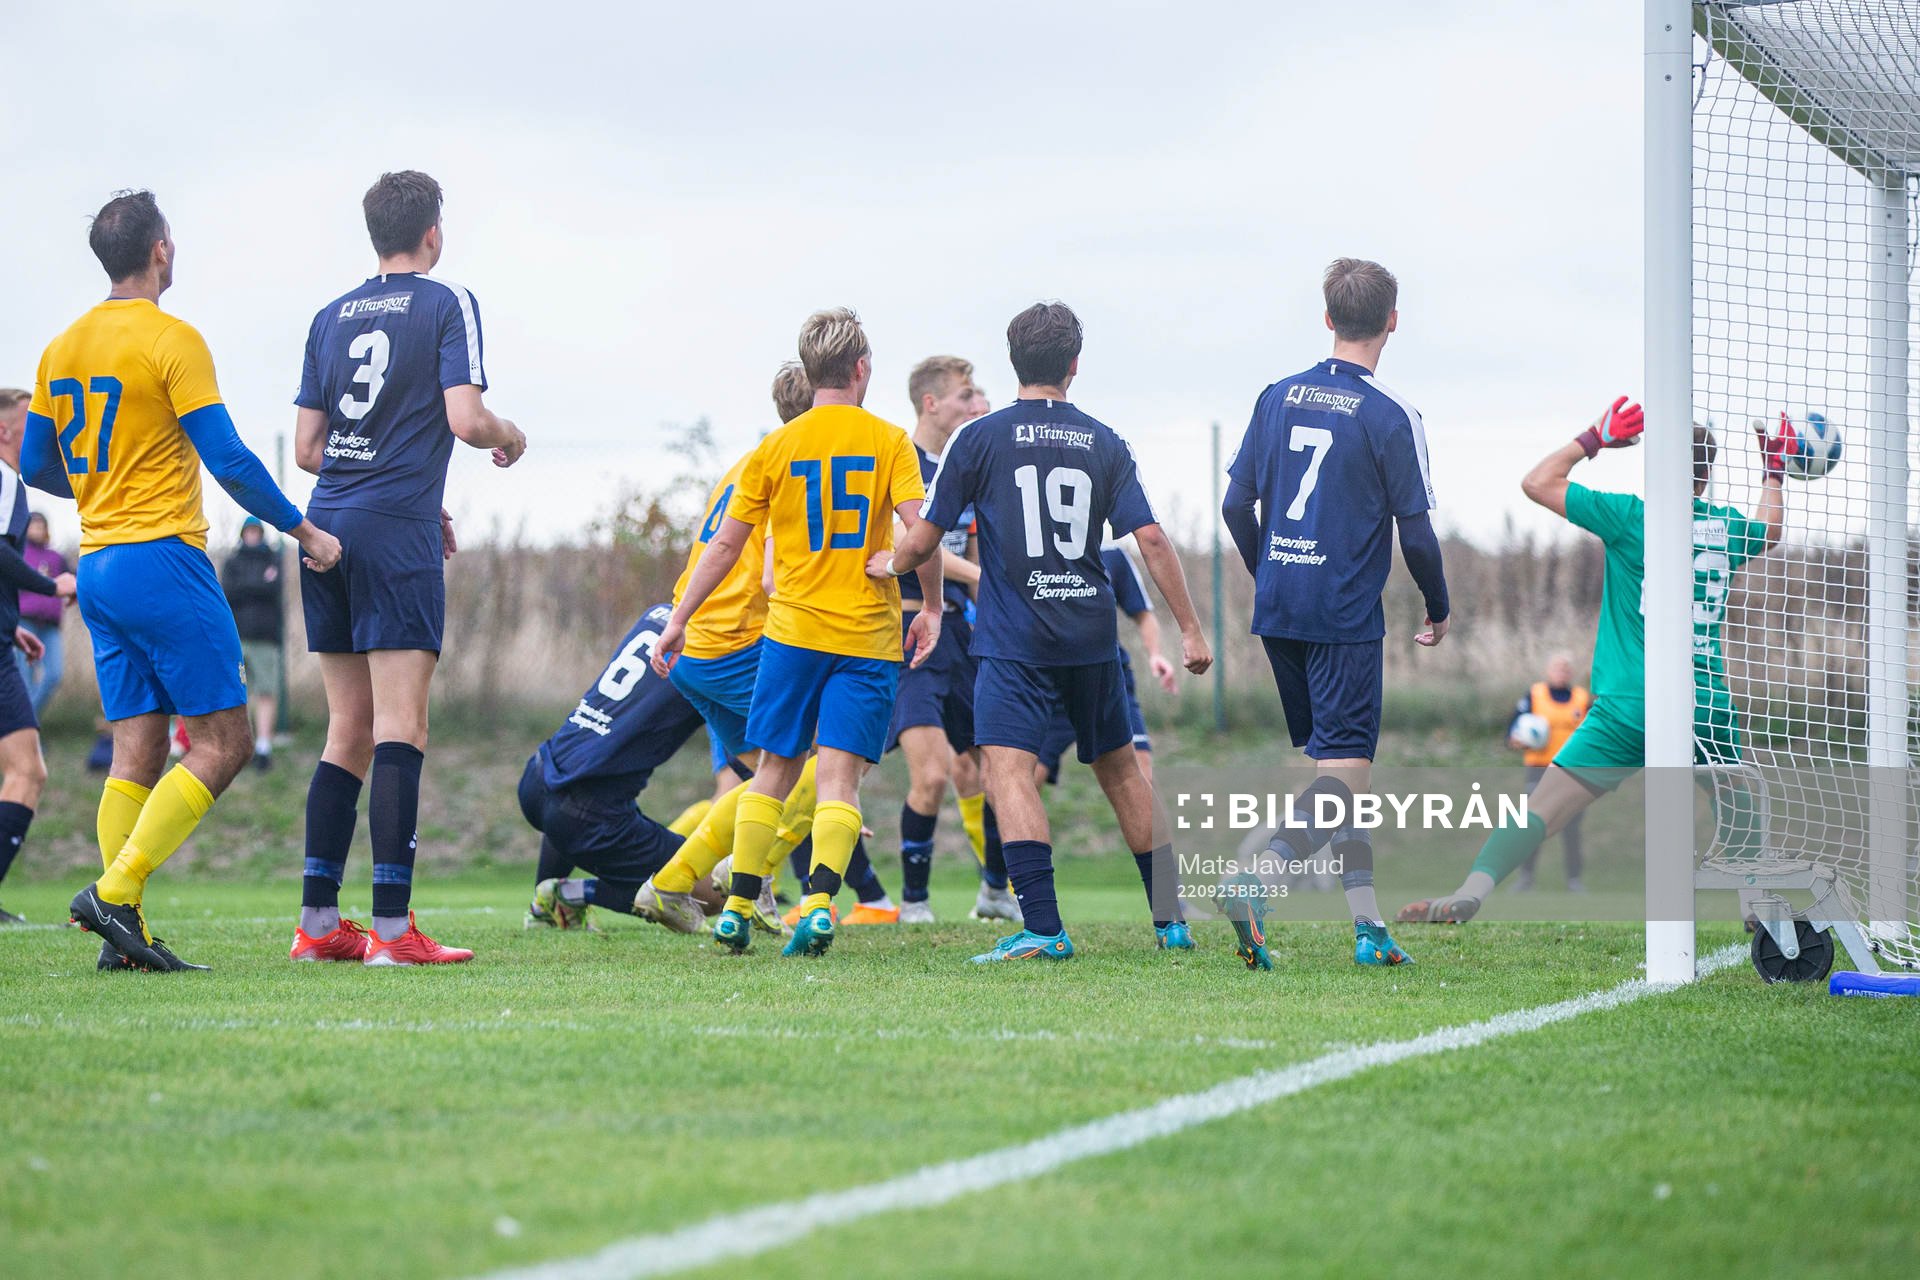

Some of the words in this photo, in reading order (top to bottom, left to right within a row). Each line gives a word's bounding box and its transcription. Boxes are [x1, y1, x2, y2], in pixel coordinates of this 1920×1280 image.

[357, 295, 411, 313] Transport
[339, 330, 390, 420] 3
[1306, 387, 1361, 411] Transport
[49, 376, 123, 474] 27
[1035, 424, 1094, 446] Transport
[790, 456, 875, 552] 15
[1014, 465, 1092, 560] 19
[1286, 425, 1333, 521] 7
[598, 630, 660, 701] 6
